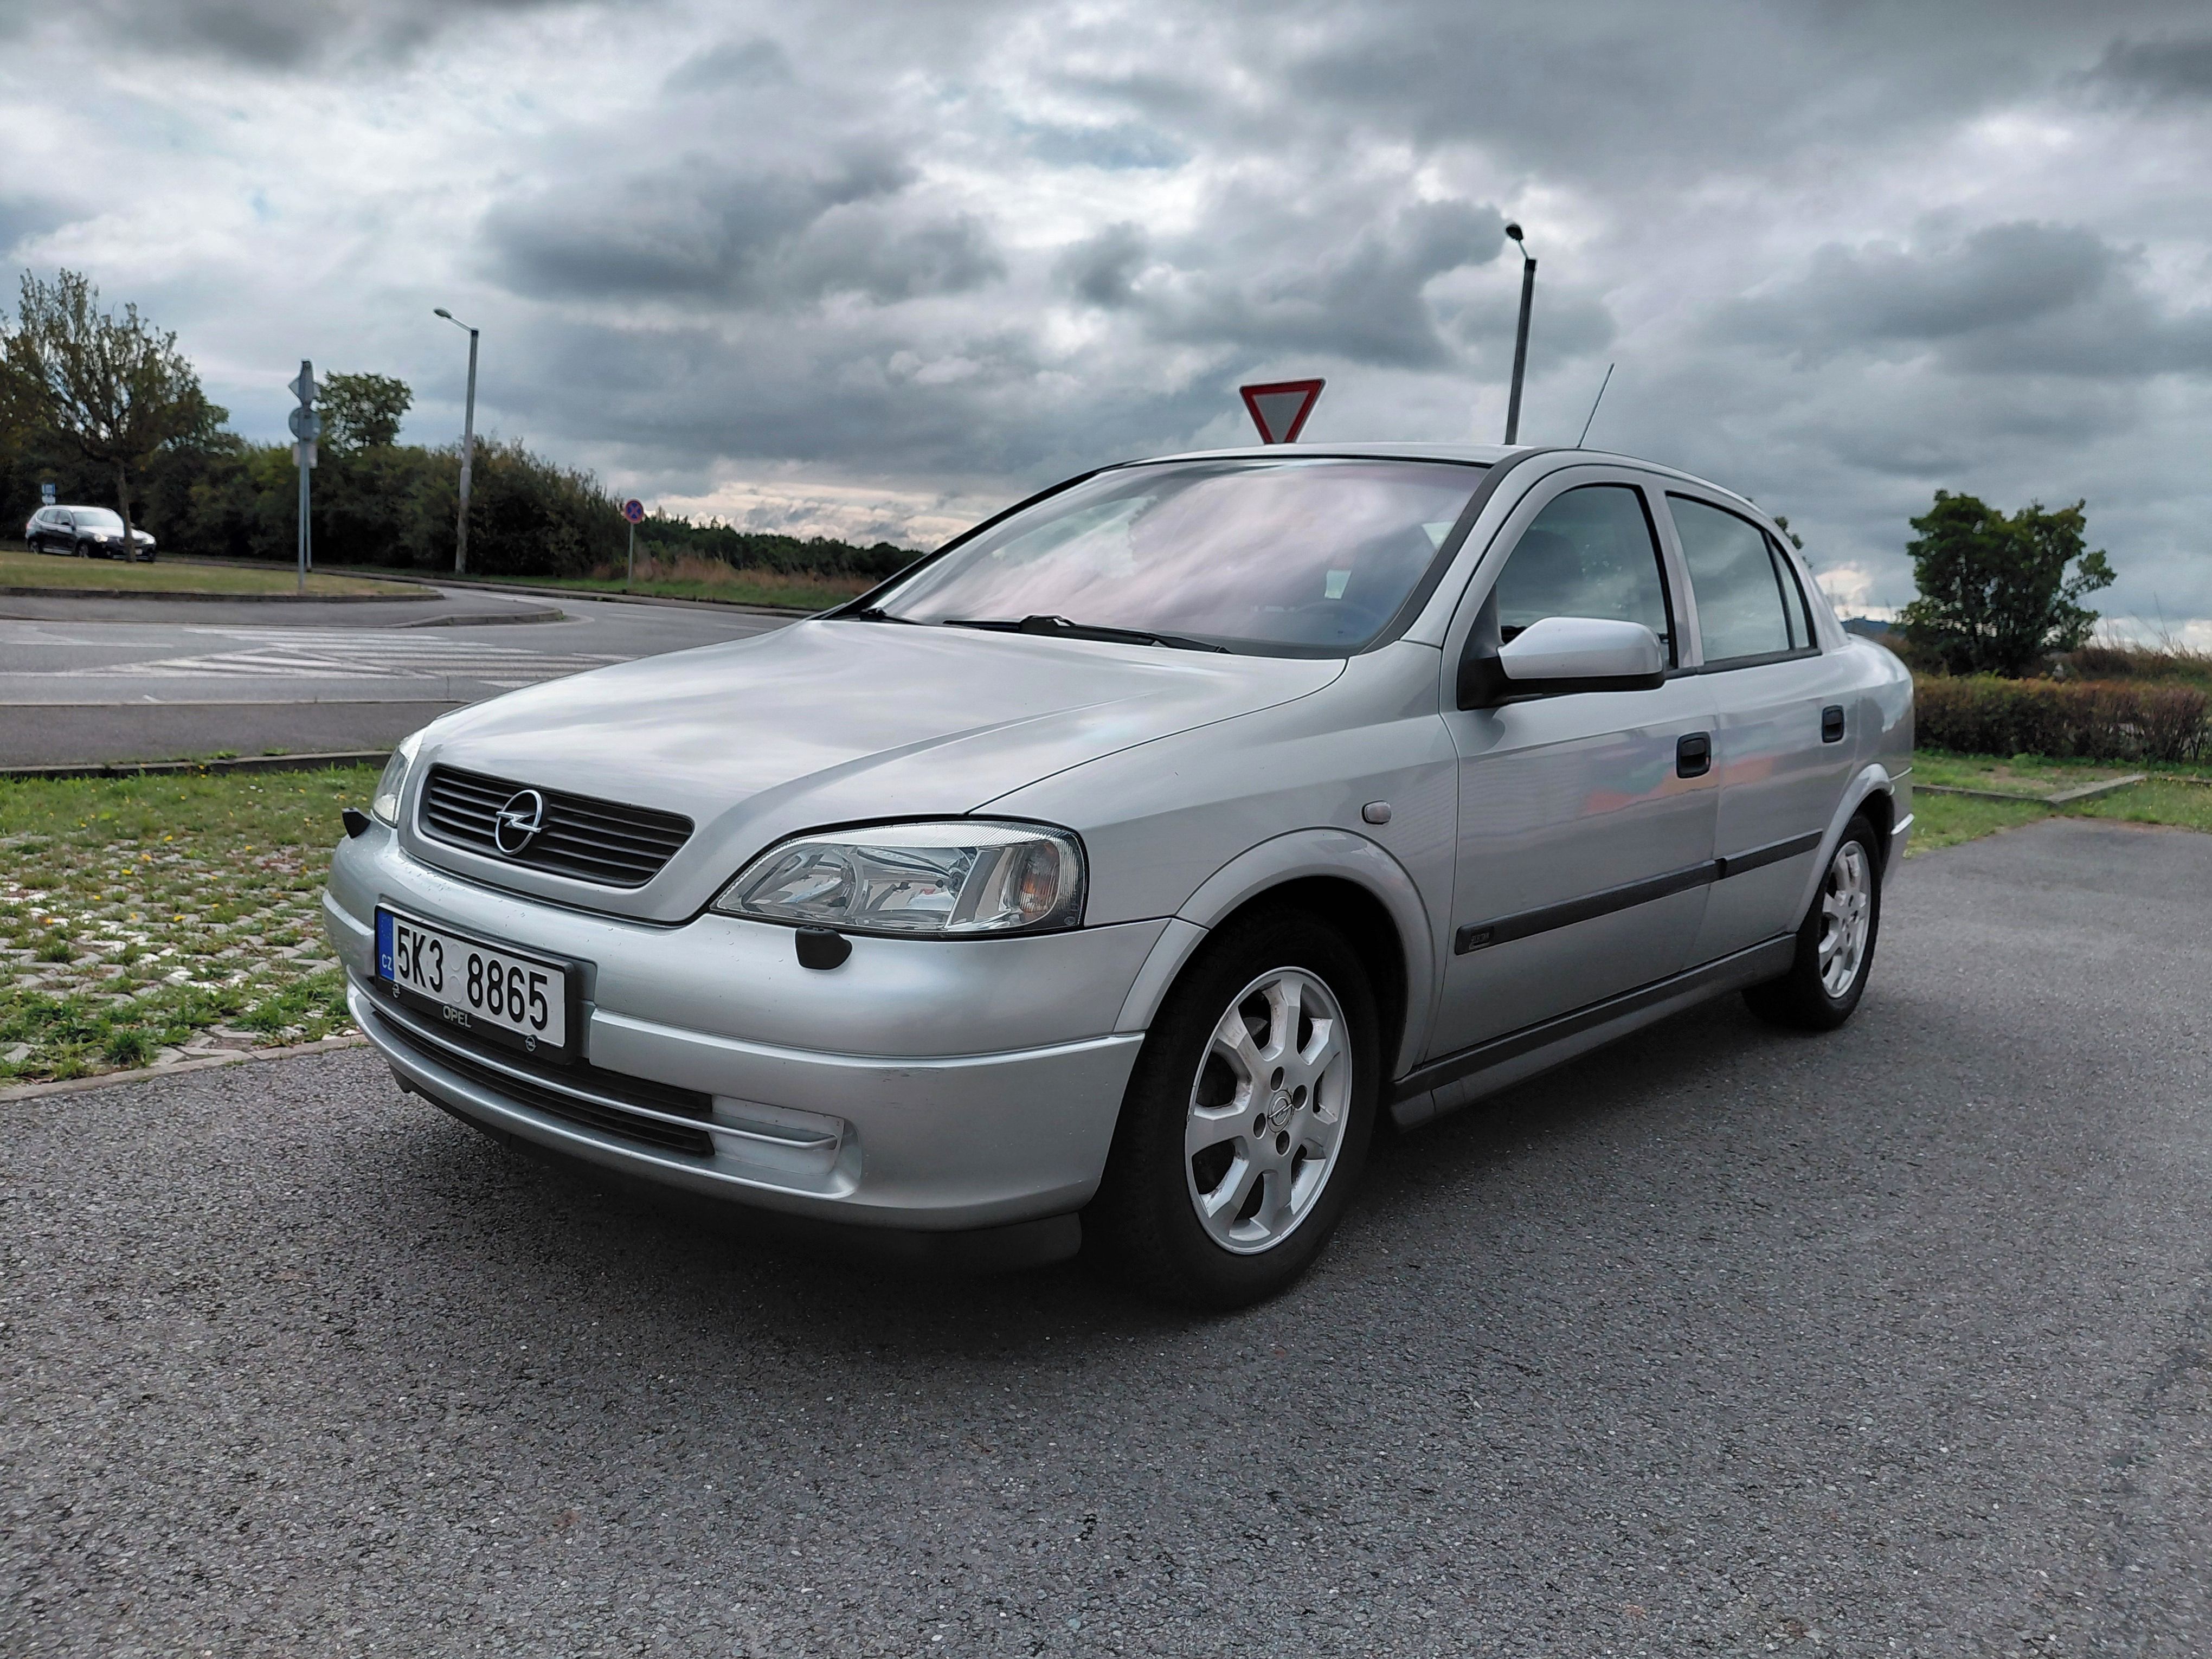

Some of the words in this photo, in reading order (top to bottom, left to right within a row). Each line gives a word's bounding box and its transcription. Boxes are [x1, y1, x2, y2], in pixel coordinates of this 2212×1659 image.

[382, 954, 393, 971] CZ
[398, 925, 443, 993] 5K3
[467, 953, 548, 1031] 8865
[443, 1005, 472, 1028] OPEL
